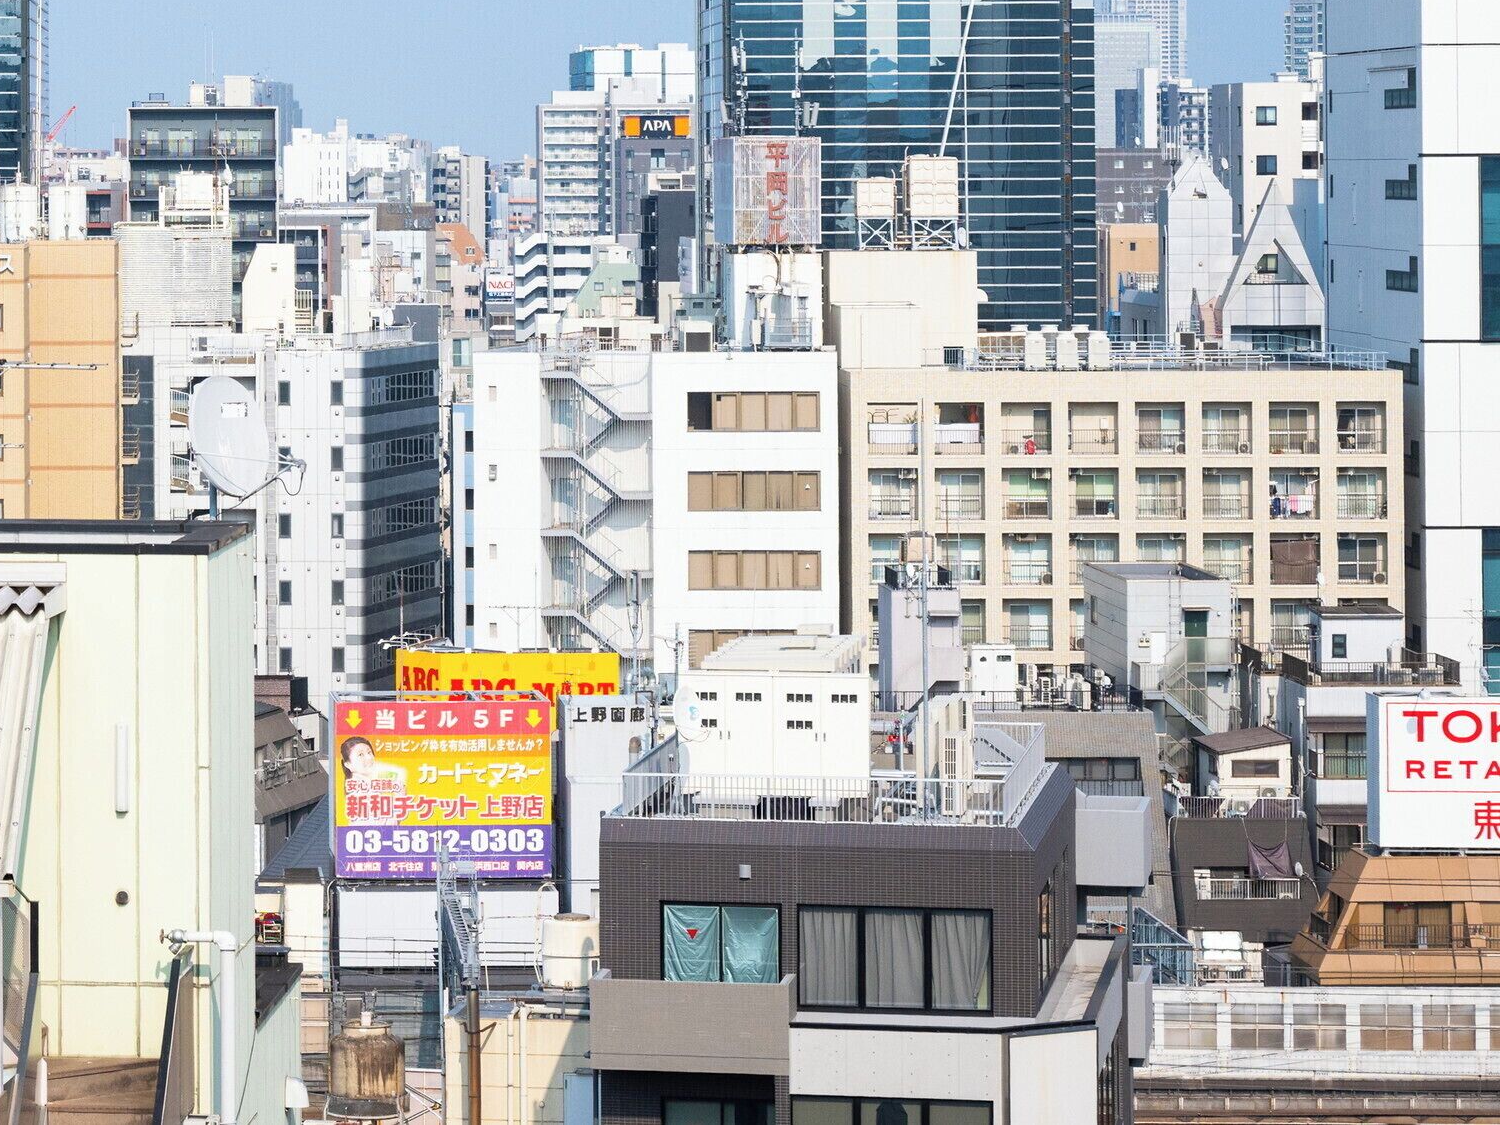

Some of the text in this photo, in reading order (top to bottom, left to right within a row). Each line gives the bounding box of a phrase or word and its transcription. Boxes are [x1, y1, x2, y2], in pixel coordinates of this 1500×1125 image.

[642, 120, 672, 131] APA
[375, 709, 514, 729] 当ビル 5F
[572, 707, 645, 723] 上野画廊
[346, 794, 544, 820] 新和チケット 上野店
[345, 828, 544, 853] 03-5812-0303
